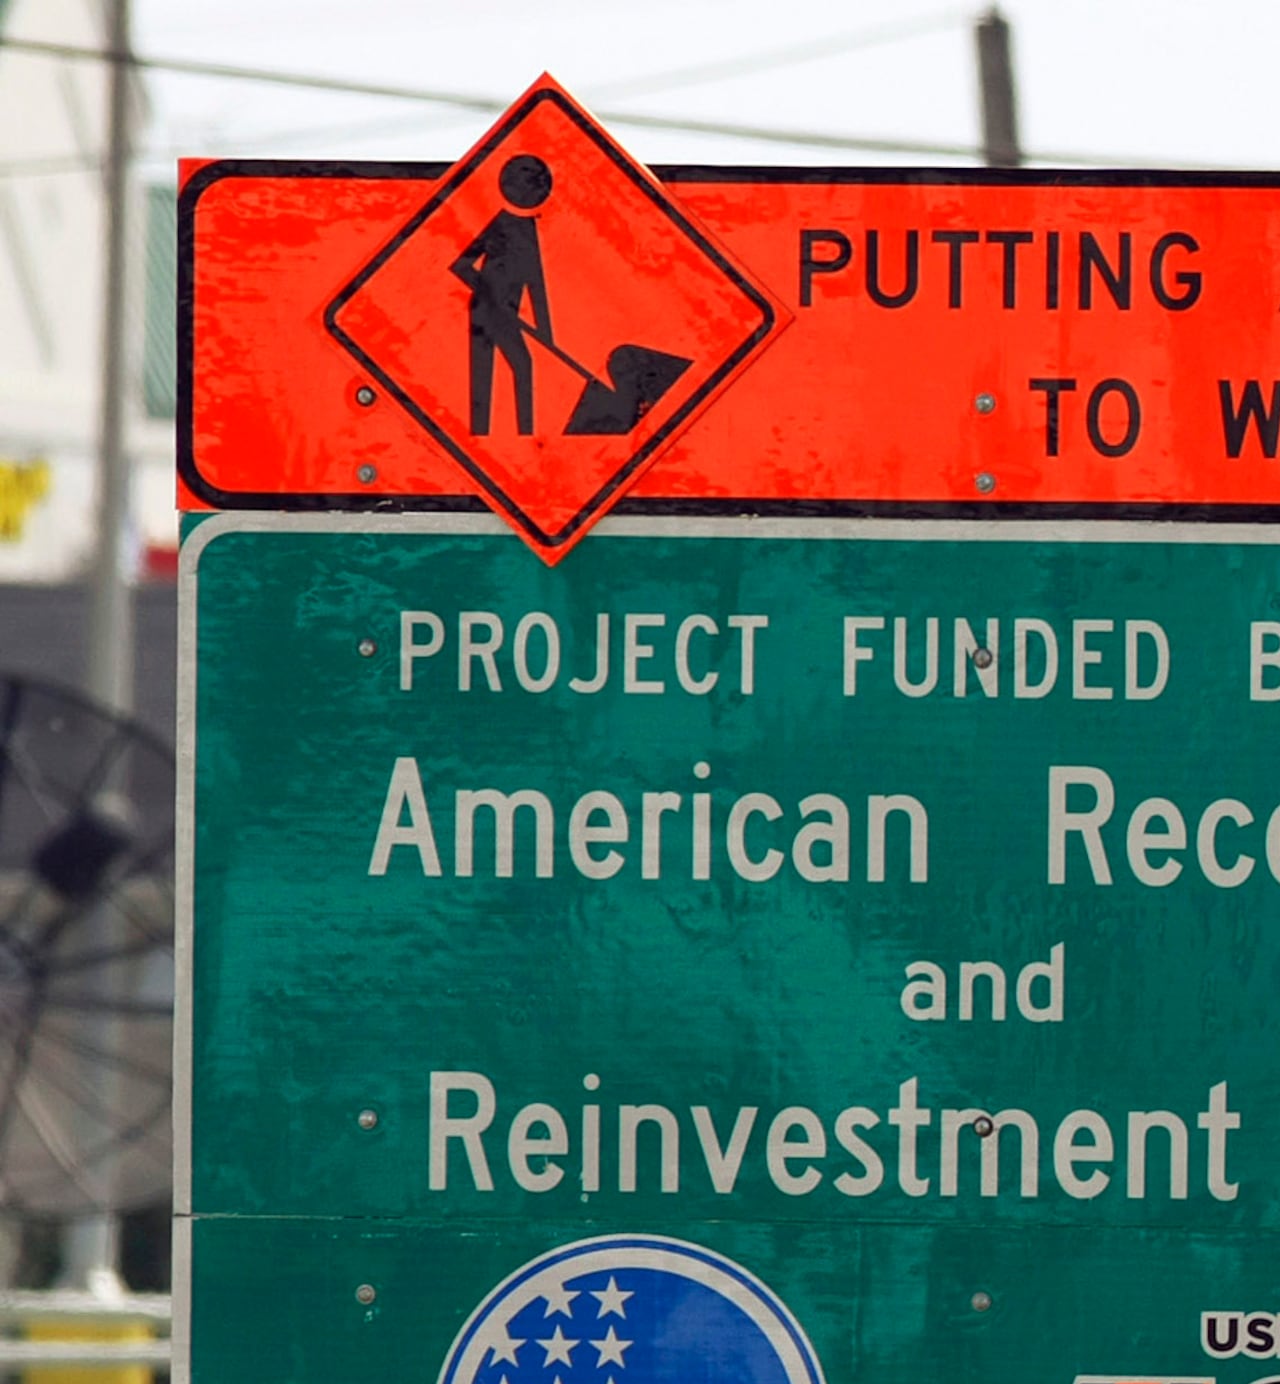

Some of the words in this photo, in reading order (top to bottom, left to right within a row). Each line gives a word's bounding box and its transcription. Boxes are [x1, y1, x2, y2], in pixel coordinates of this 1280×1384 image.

[800, 229, 1202, 310] PUTTING
[1030, 378, 1141, 457] TO
[399, 610, 769, 695] PROJECT
[842, 616, 1170, 699] FUNDED
[368, 756, 928, 883] American
[900, 941, 1064, 1022] and
[428, 1071, 1241, 1200] Reinvestment
